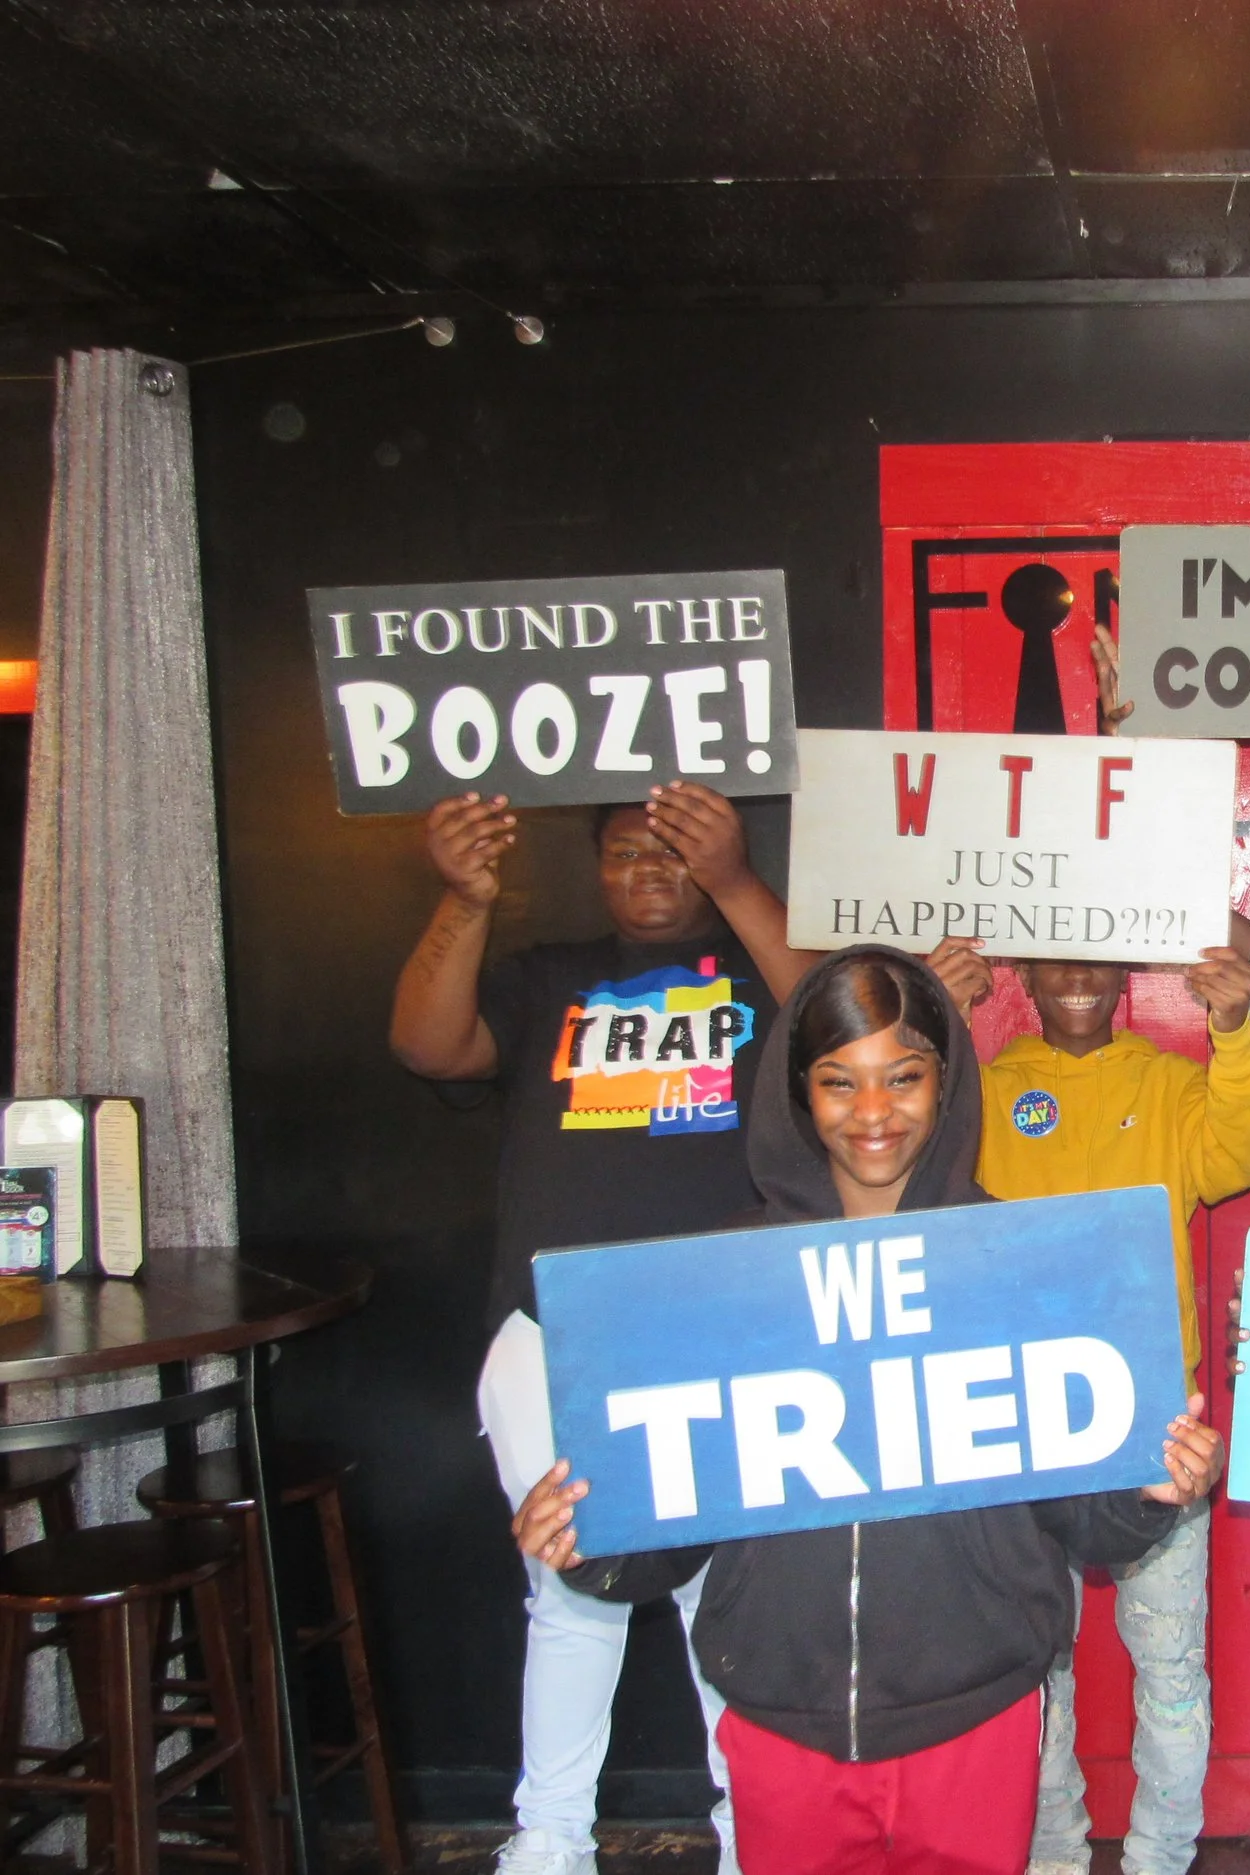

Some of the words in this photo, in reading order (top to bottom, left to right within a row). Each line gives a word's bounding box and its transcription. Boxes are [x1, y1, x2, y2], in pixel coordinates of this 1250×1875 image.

[328, 612, 357, 659] I
[371, 603, 617, 657] FOUND
[634, 597, 768, 645] THE
[337, 659, 772, 788] BOOZE!
[945, 849, 1070, 889] JUST
[831, 897, 1188, 947] HAPPENED?!?!
[567, 1005, 747, 1068] TRAP
[1035, 1100, 1048, 1110] MY
[798, 1233, 932, 1346] WE
[605, 1335, 1137, 1522] TRIED
